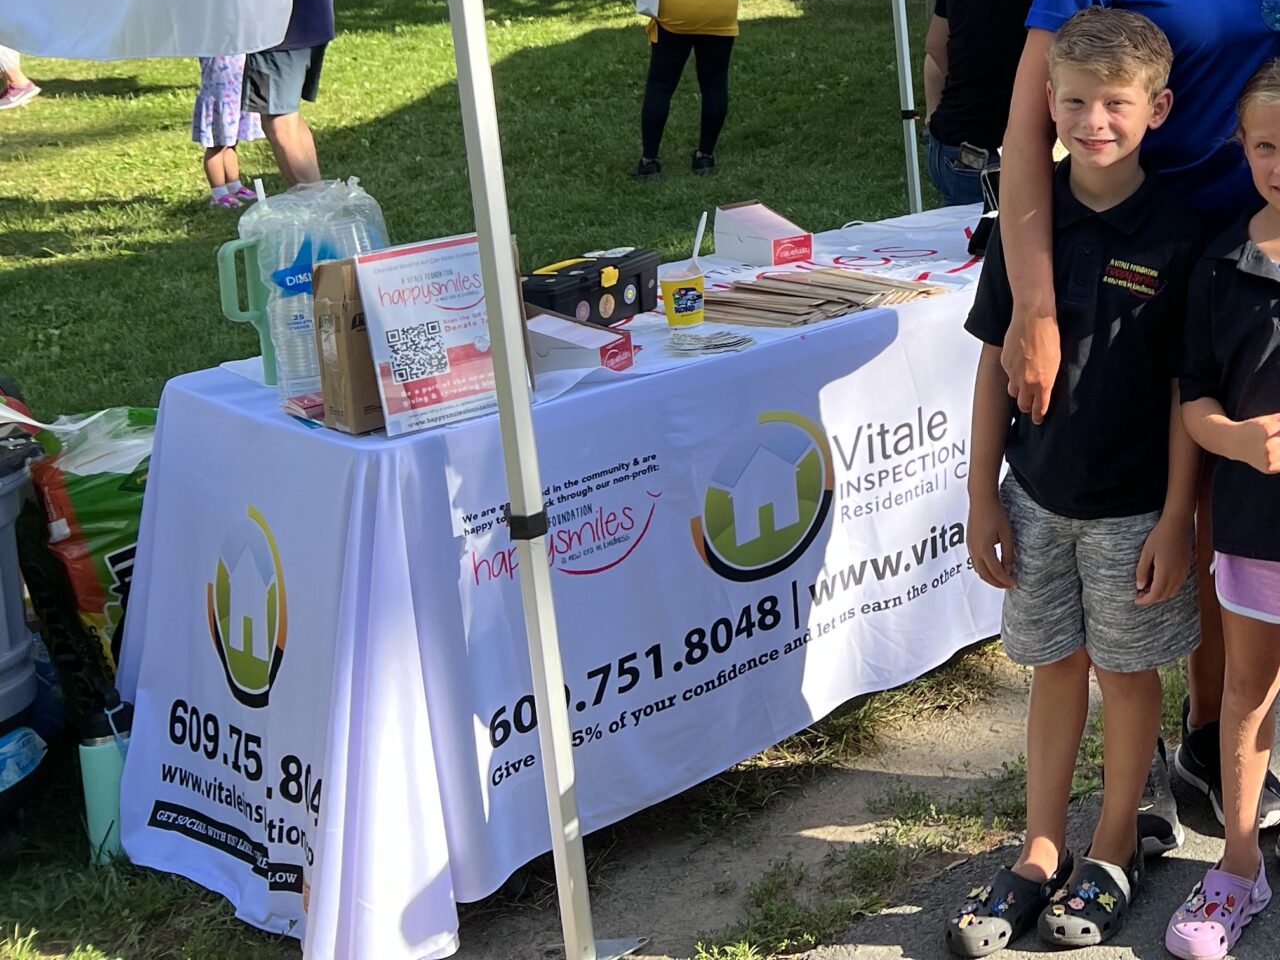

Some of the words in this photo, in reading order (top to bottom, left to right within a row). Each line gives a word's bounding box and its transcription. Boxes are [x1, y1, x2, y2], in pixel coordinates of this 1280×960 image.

[378, 272, 482, 307] happysmiles
[445, 321, 477, 332] Donate
[832, 406, 948, 471] Vitale
[462, 514, 479, 524] We
[481, 507, 497, 518] are
[553, 485, 562, 493] in
[564, 479, 579, 489] the
[581, 462, 631, 483] community
[632, 458, 640, 466] &
[642, 454, 657, 463] are
[464, 519, 493, 537] happy
[556, 485, 593, 503] through
[595, 480, 611, 491] our
[613, 464, 660, 485] non-profit:
[840, 439, 966, 501] INSPECTION
[841, 475, 939, 524] Residential
[547, 503, 593, 528] FOUNDATION
[489, 595, 782, 749] 60.751.8048
[491, 751, 536, 787] Give
[608, 709, 629, 734] of
[630, 694, 677, 727] your
[682, 648, 780, 702] confidence
[783, 628, 813, 655] and
[817, 619, 836, 638] let
[839, 607, 856, 625] us
[861, 595, 902, 615] earn
[907, 582, 928, 602] the
[931, 562, 963, 589] other
[156, 809, 178, 823] GET
[175, 815, 207, 835] SOCIAL
[207, 825, 226, 840] WITH
